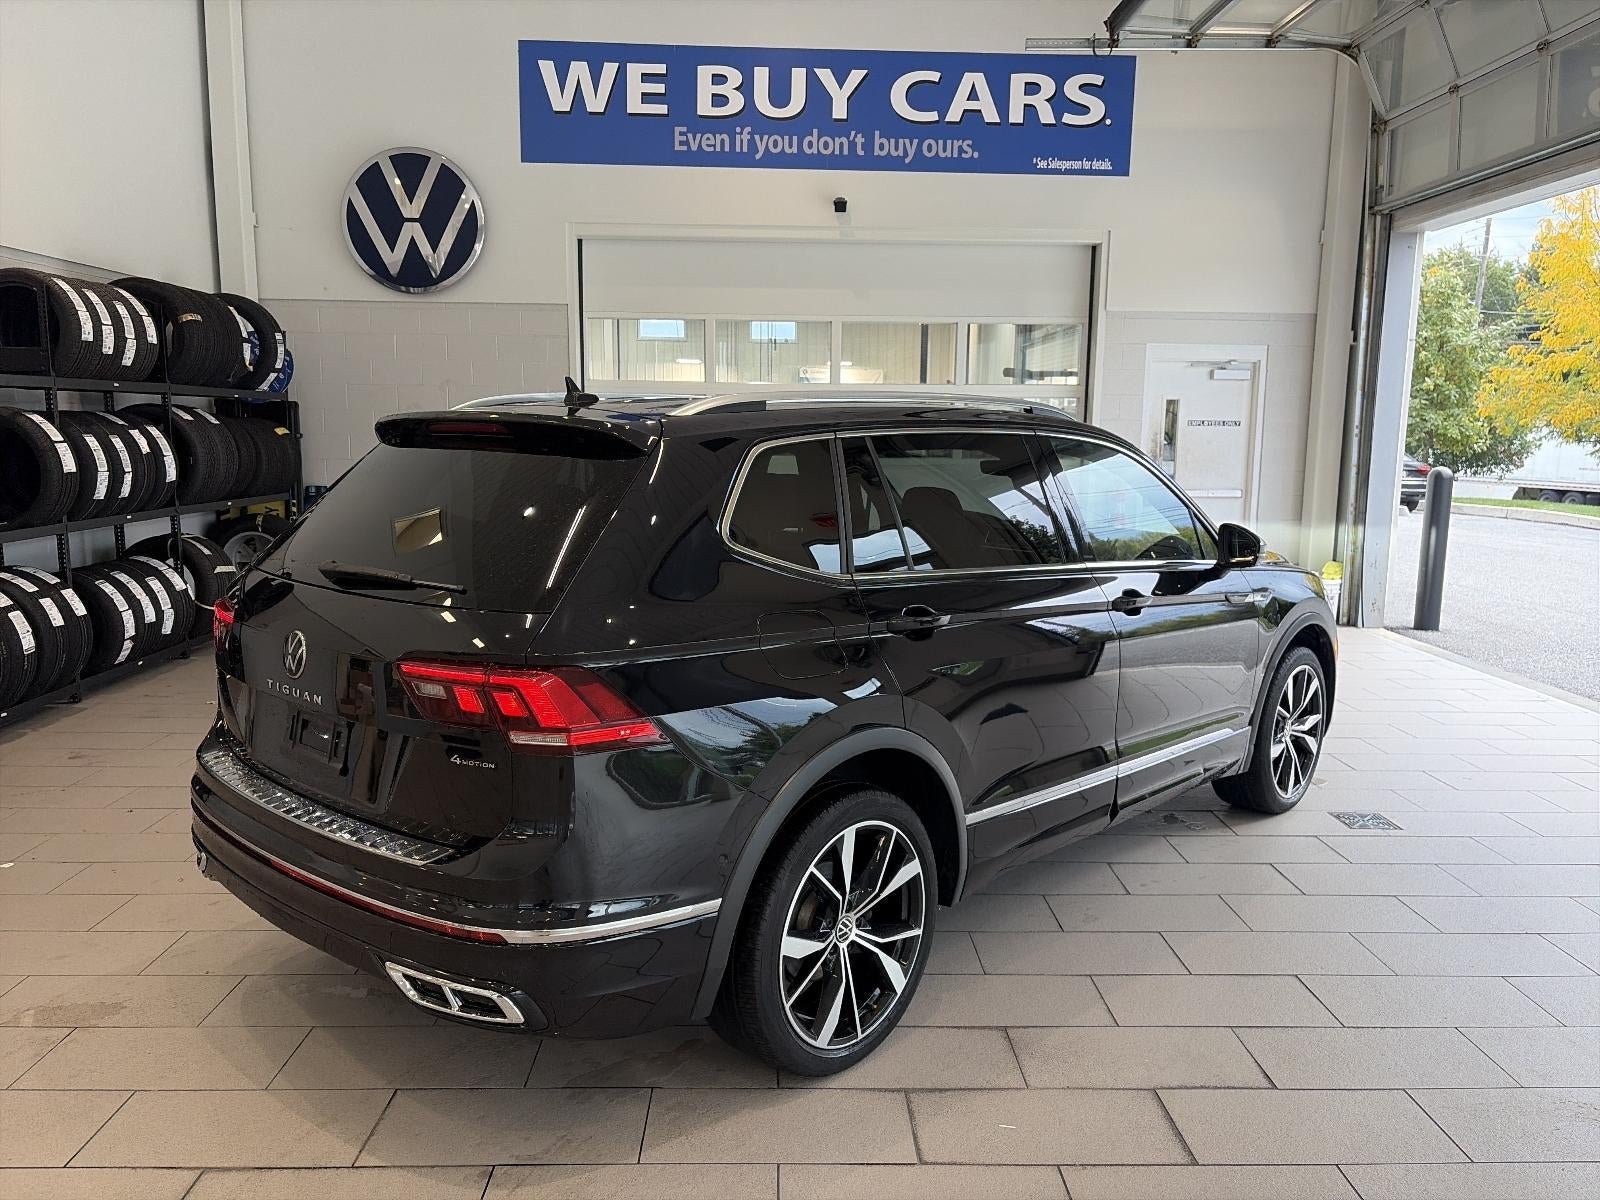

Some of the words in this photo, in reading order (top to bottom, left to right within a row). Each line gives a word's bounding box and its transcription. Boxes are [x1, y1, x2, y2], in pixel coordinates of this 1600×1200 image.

[537, 59, 669, 117] WE
[696, 64, 870, 120] BUY
[673, 126, 730, 153] Even
[734, 126, 752, 153] if
[753, 133, 798, 160] you
[802, 128, 866, 157] don't
[873, 130, 919, 164] buy
[921, 137, 979, 159] ours.
[1048, 157, 1082, 171] Salesperson
[1082, 157, 1092, 170] for
[1092, 158, 1112, 170] details.
[1187, 419, 1224, 427] EMPLOYEES
[1224, 419, 1241, 427] ONLY
[266, 678, 323, 706] TIGUAN
[450, 754, 496, 769] 4MOTION
